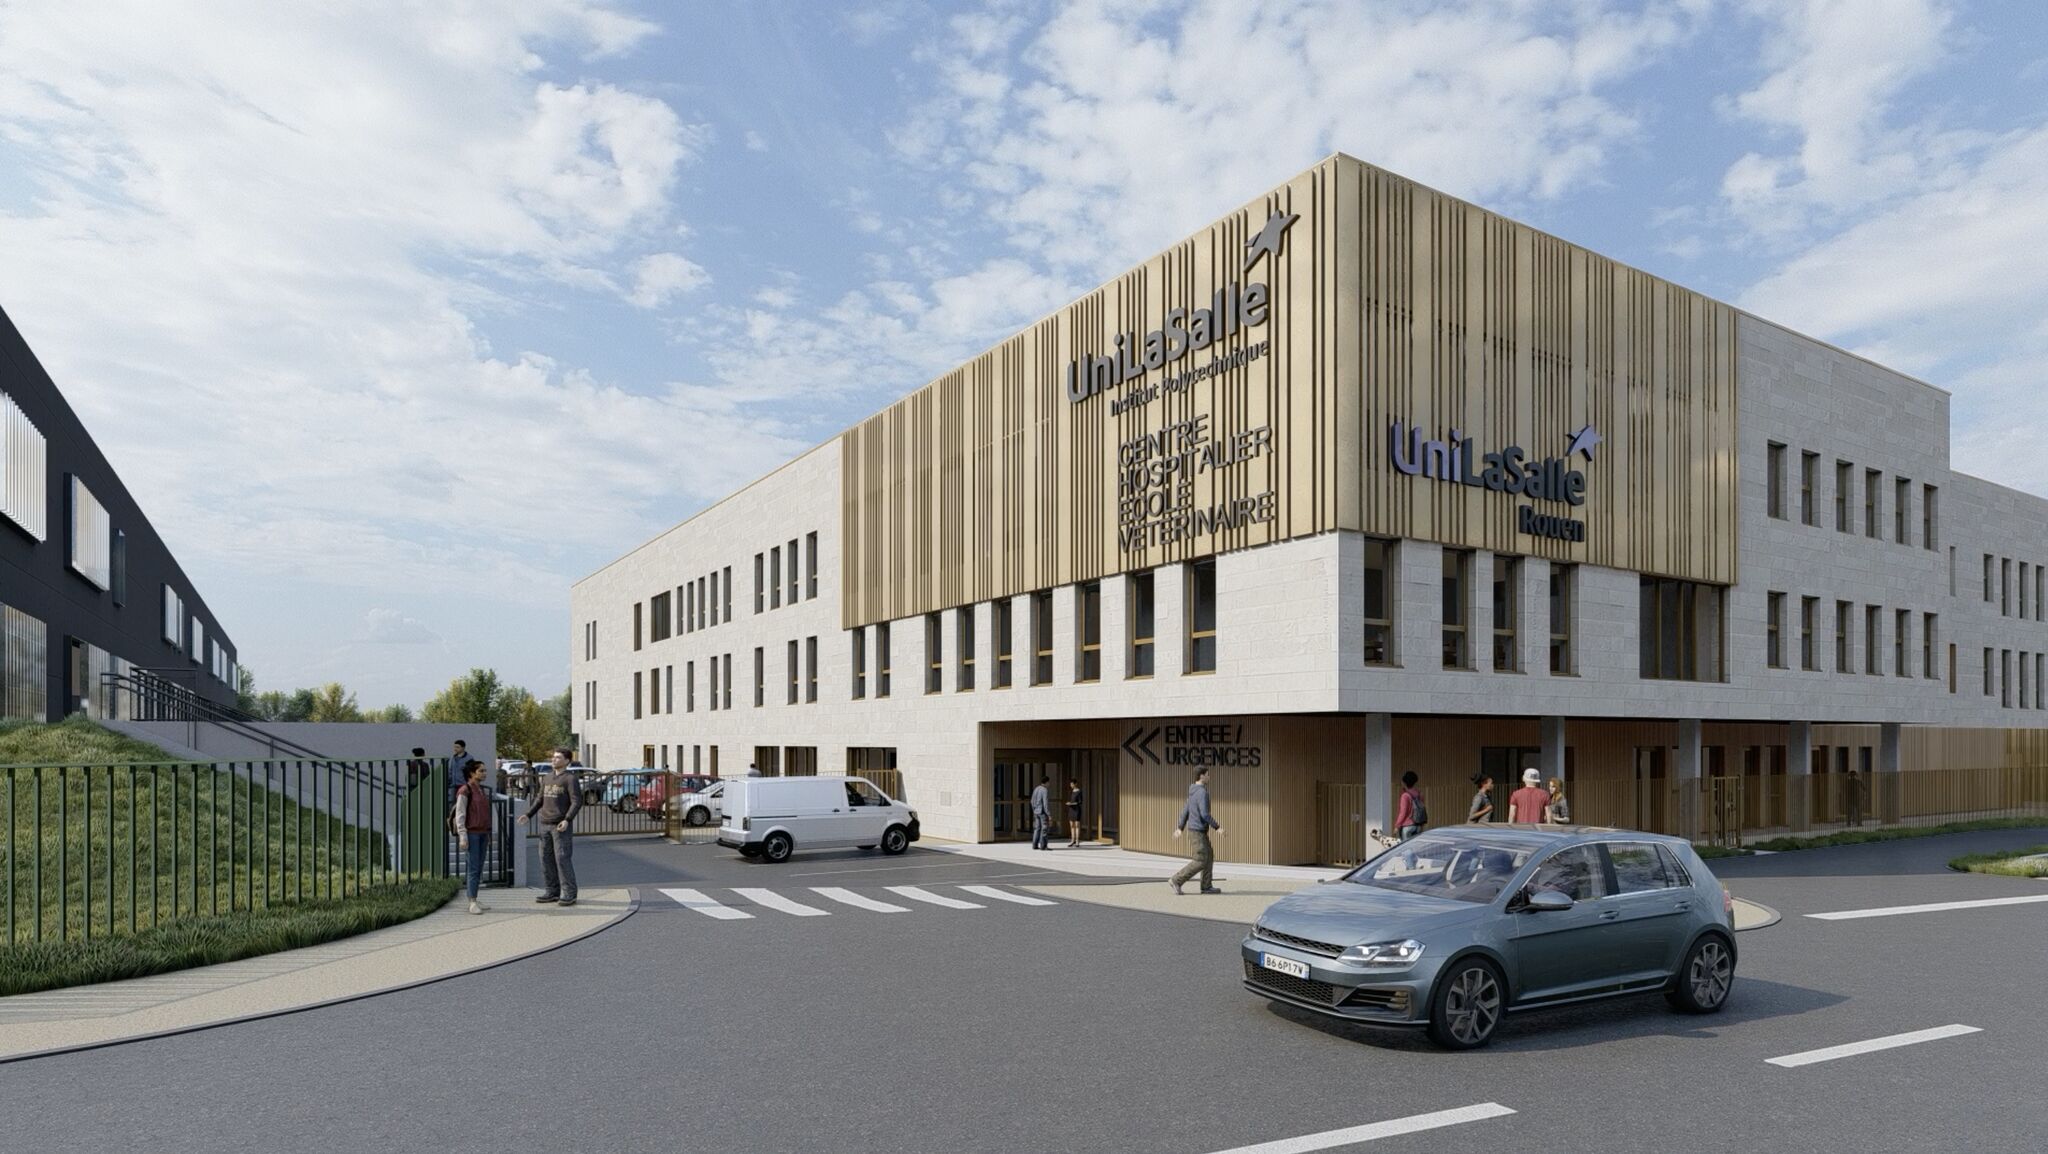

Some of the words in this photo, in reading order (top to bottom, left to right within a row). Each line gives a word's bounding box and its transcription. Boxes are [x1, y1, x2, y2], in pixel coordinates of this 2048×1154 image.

[1067, 281, 1269, 403] UniLaSalle
[1110, 383, 1160, 417] Institut
[1161, 340, 1270, 396] Polytechnique
[1118, 413, 1209, 469] CENTRE
[1118, 425, 1274, 498] HOSPITALIER
[1391, 422, 1586, 506] UniLaSalle
[1118, 490, 1275, 554] VETERINAIRE
[1519, 504, 1585, 542] Rouen
[1165, 724, 1232, 744] ENTREE
[1165, 746, 1262, 767] URGENCES
